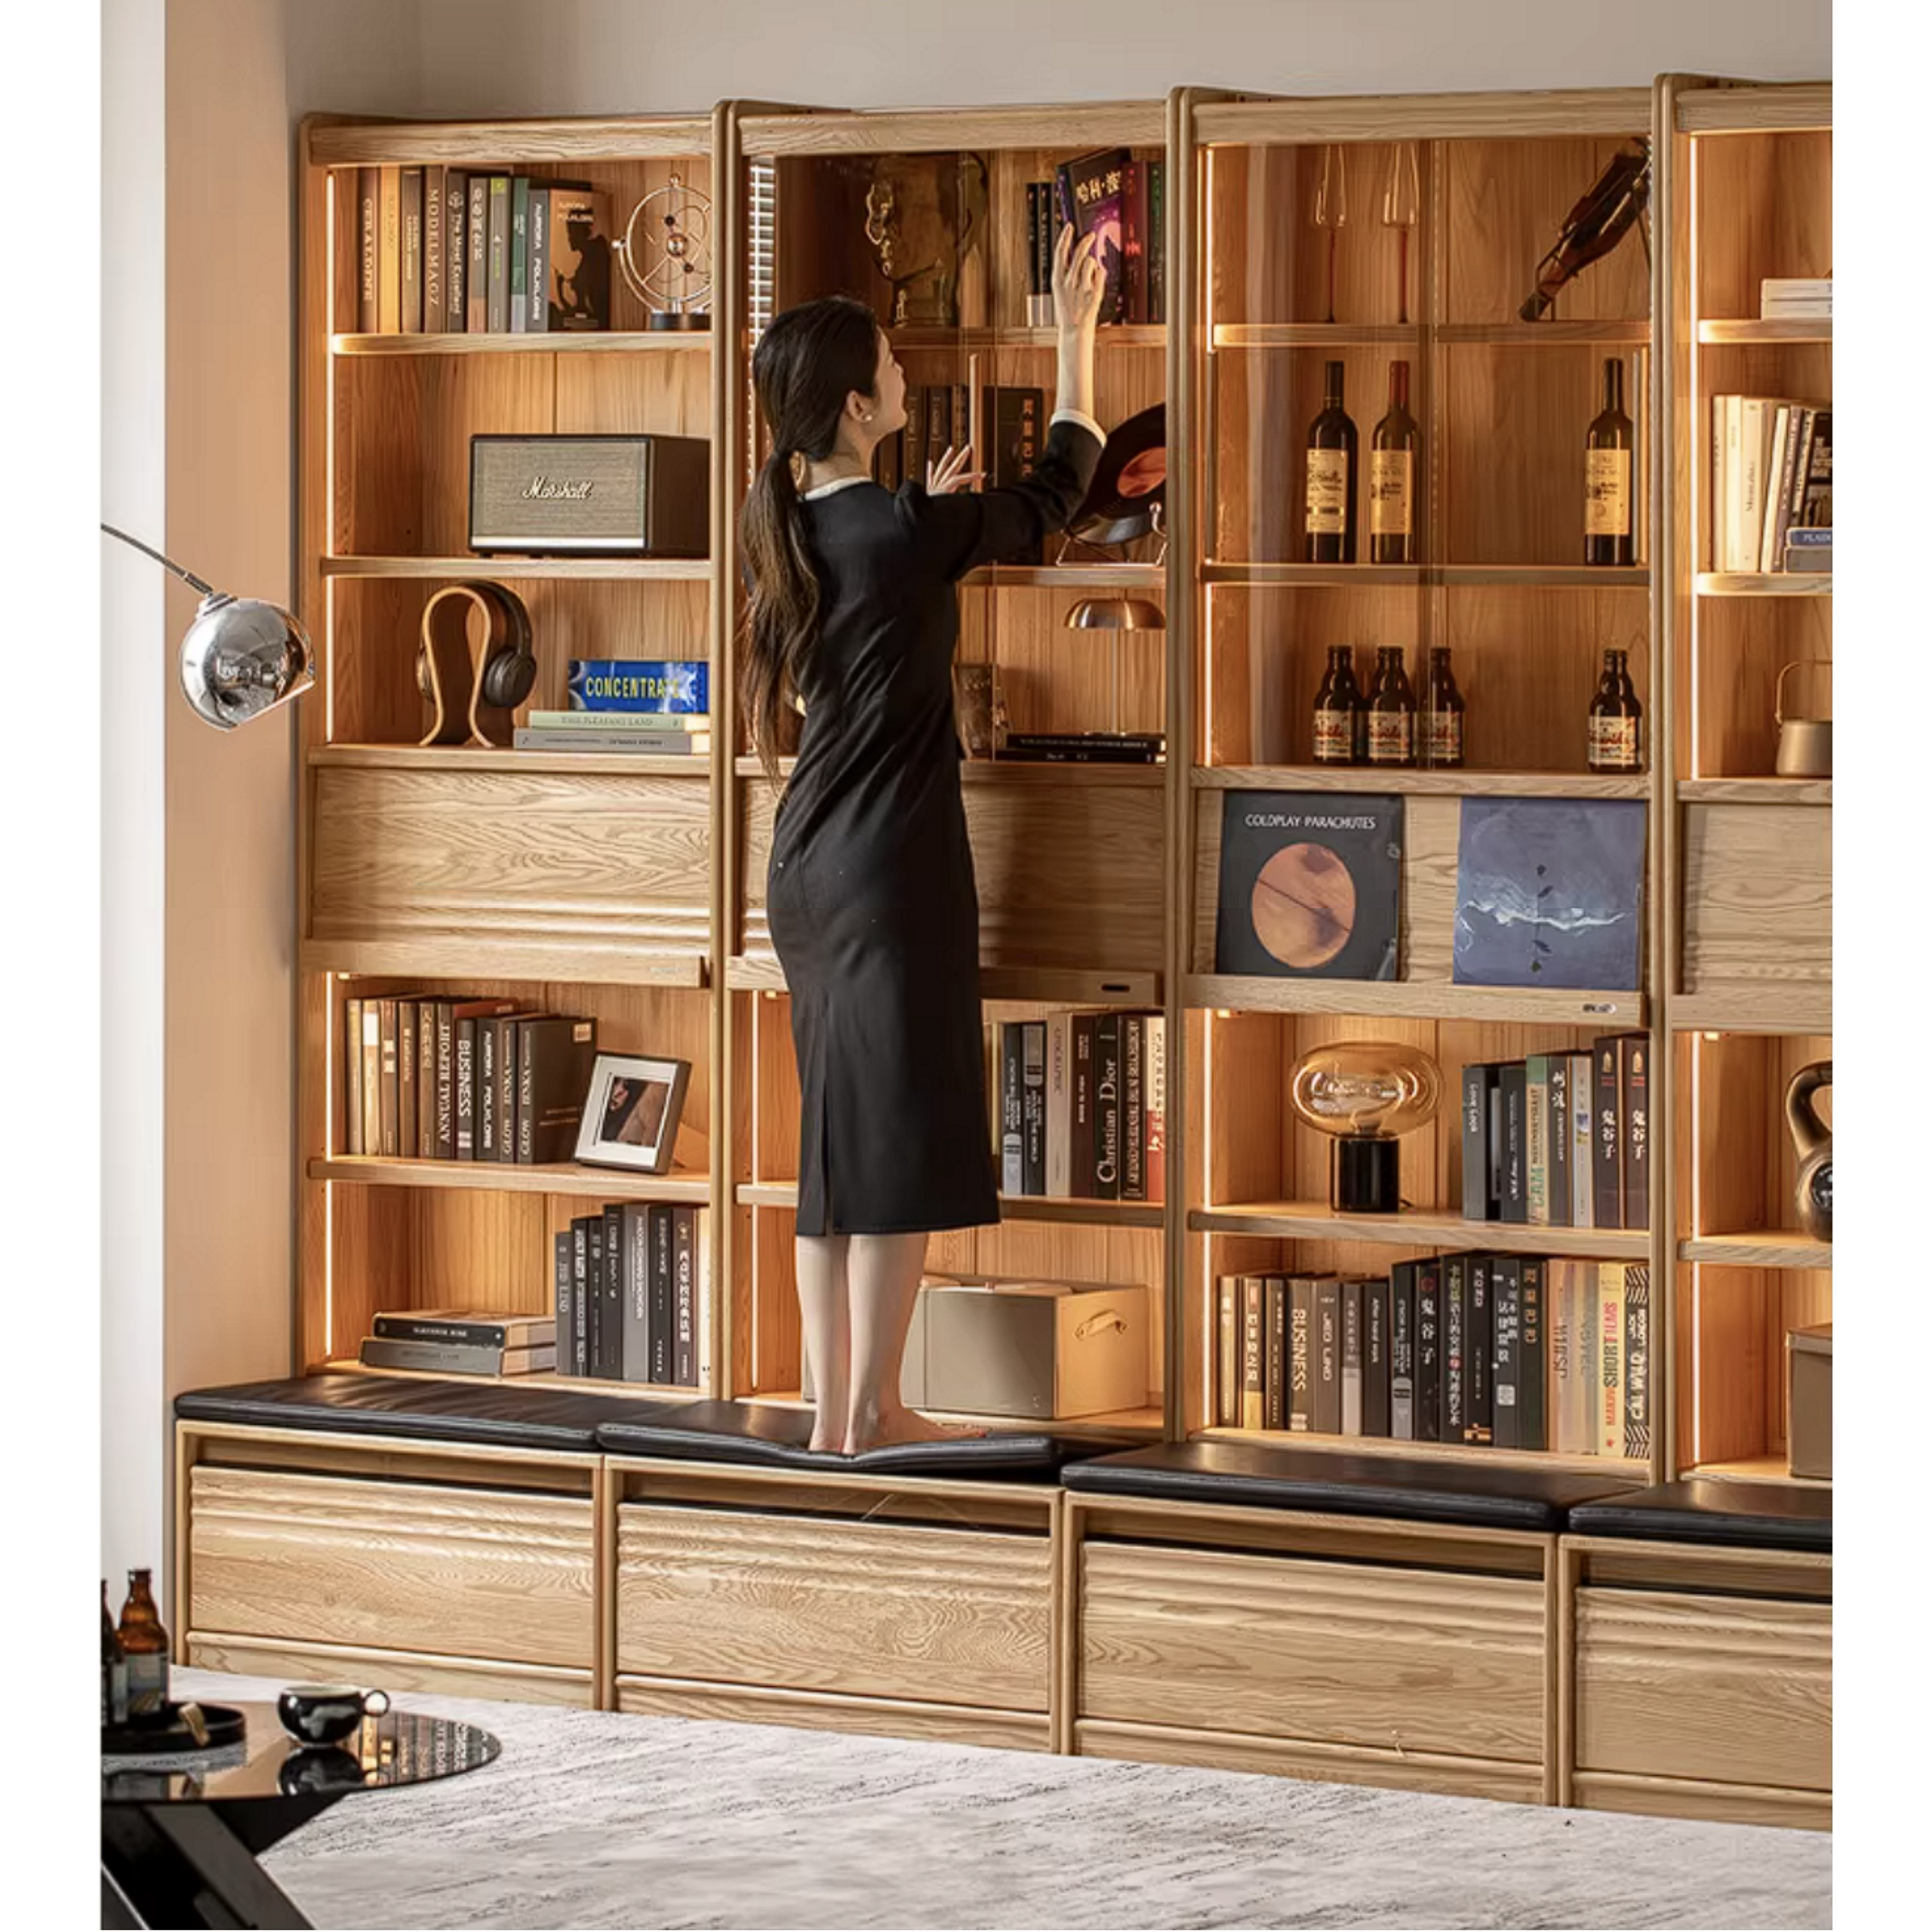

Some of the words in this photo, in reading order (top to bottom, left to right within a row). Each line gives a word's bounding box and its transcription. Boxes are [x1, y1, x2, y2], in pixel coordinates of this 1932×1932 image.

[522, 476, 593, 499] Marshall
[1245, 814, 1302, 827] COLDPLAY
[1304, 816, 1376, 829] PARACHUTES
[458, 1040, 471, 1117] BUSINESS
[1098, 1058, 1116, 1101] Dior
[440, 1085, 451, 1143] ANNUAL
[1097, 1110, 1116, 1183] Christian
[1292, 1308, 1306, 1391] BUSINESS
[1603, 1340, 1619, 1388] SHORT
